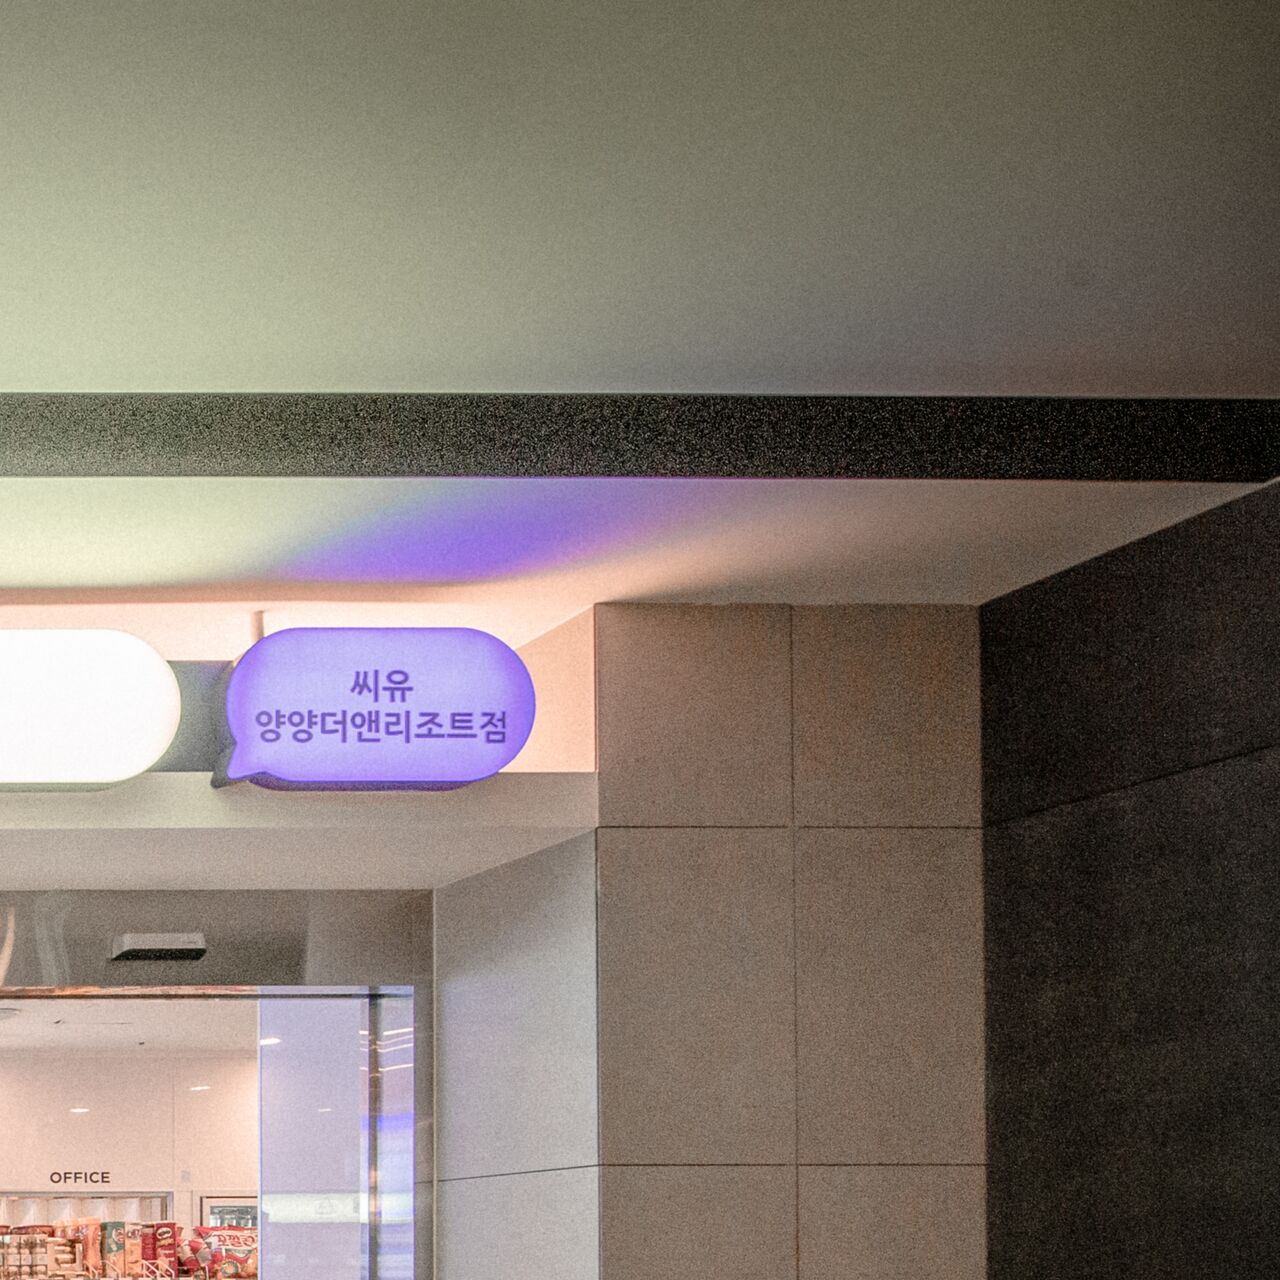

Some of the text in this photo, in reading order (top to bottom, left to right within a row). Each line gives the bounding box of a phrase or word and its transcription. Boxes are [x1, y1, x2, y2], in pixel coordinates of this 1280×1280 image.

[349, 668, 415, 703] 씨유
[254, 708, 508, 745] 양양더앤리조트점
[49, 1171, 111, 1184] OFFICE
